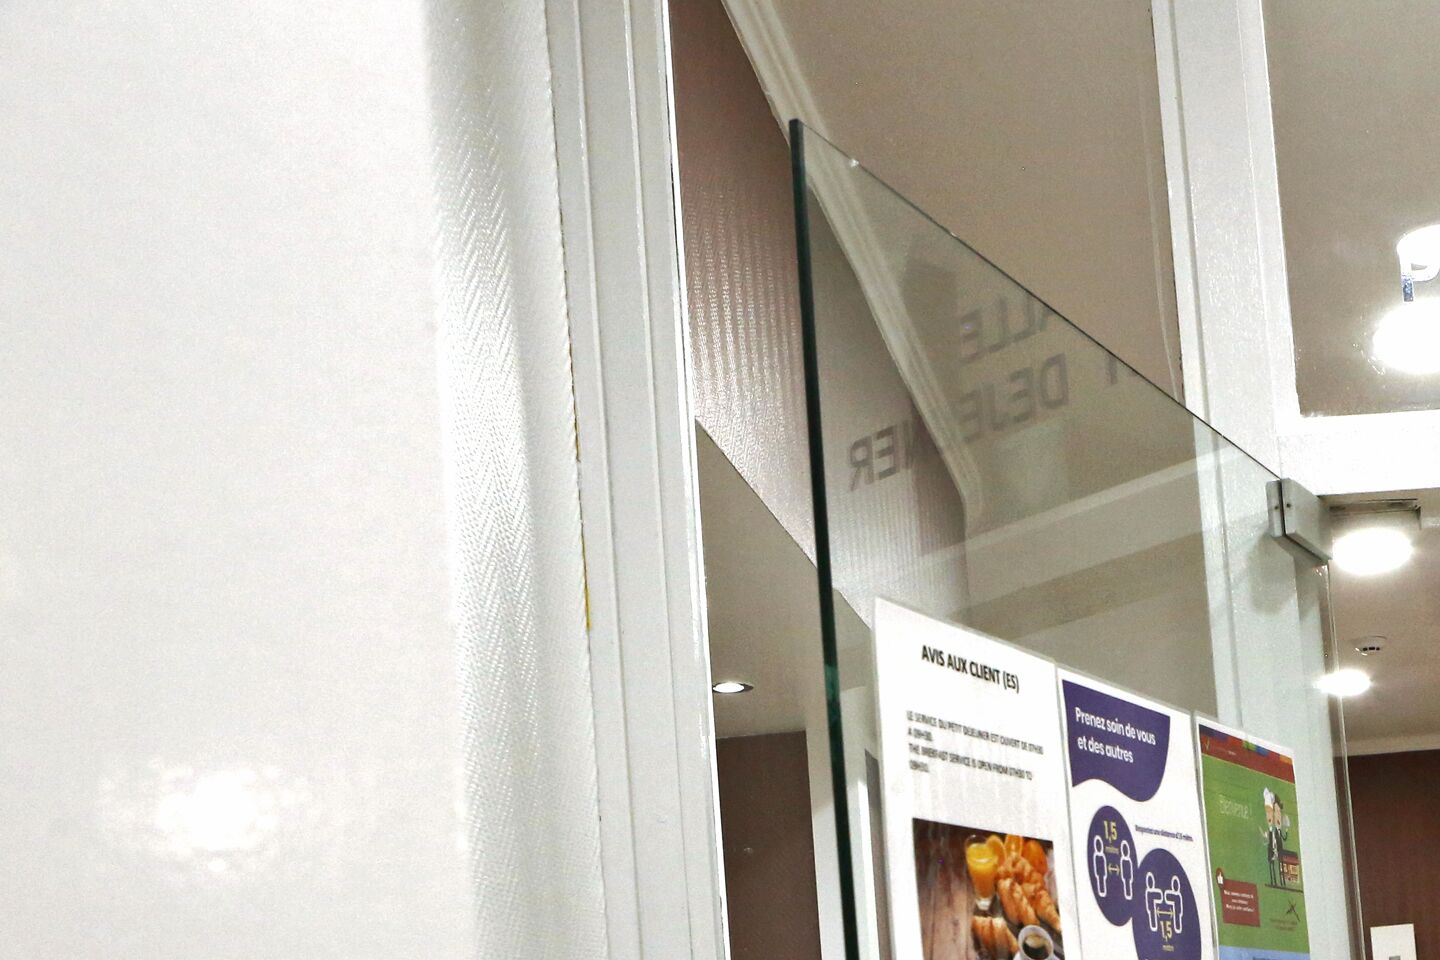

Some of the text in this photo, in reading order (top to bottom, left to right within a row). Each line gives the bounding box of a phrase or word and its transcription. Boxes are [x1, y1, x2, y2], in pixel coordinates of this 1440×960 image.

[921, 644, 1020, 694] AVIS AUX CLIENT (ES)
[1074, 706, 1157, 746] Prenez soin de vous
[1077, 735, 1134, 763] et des autres
[1103, 820, 1118, 844] 1,5
[1160, 920, 1173, 942] 1,5
